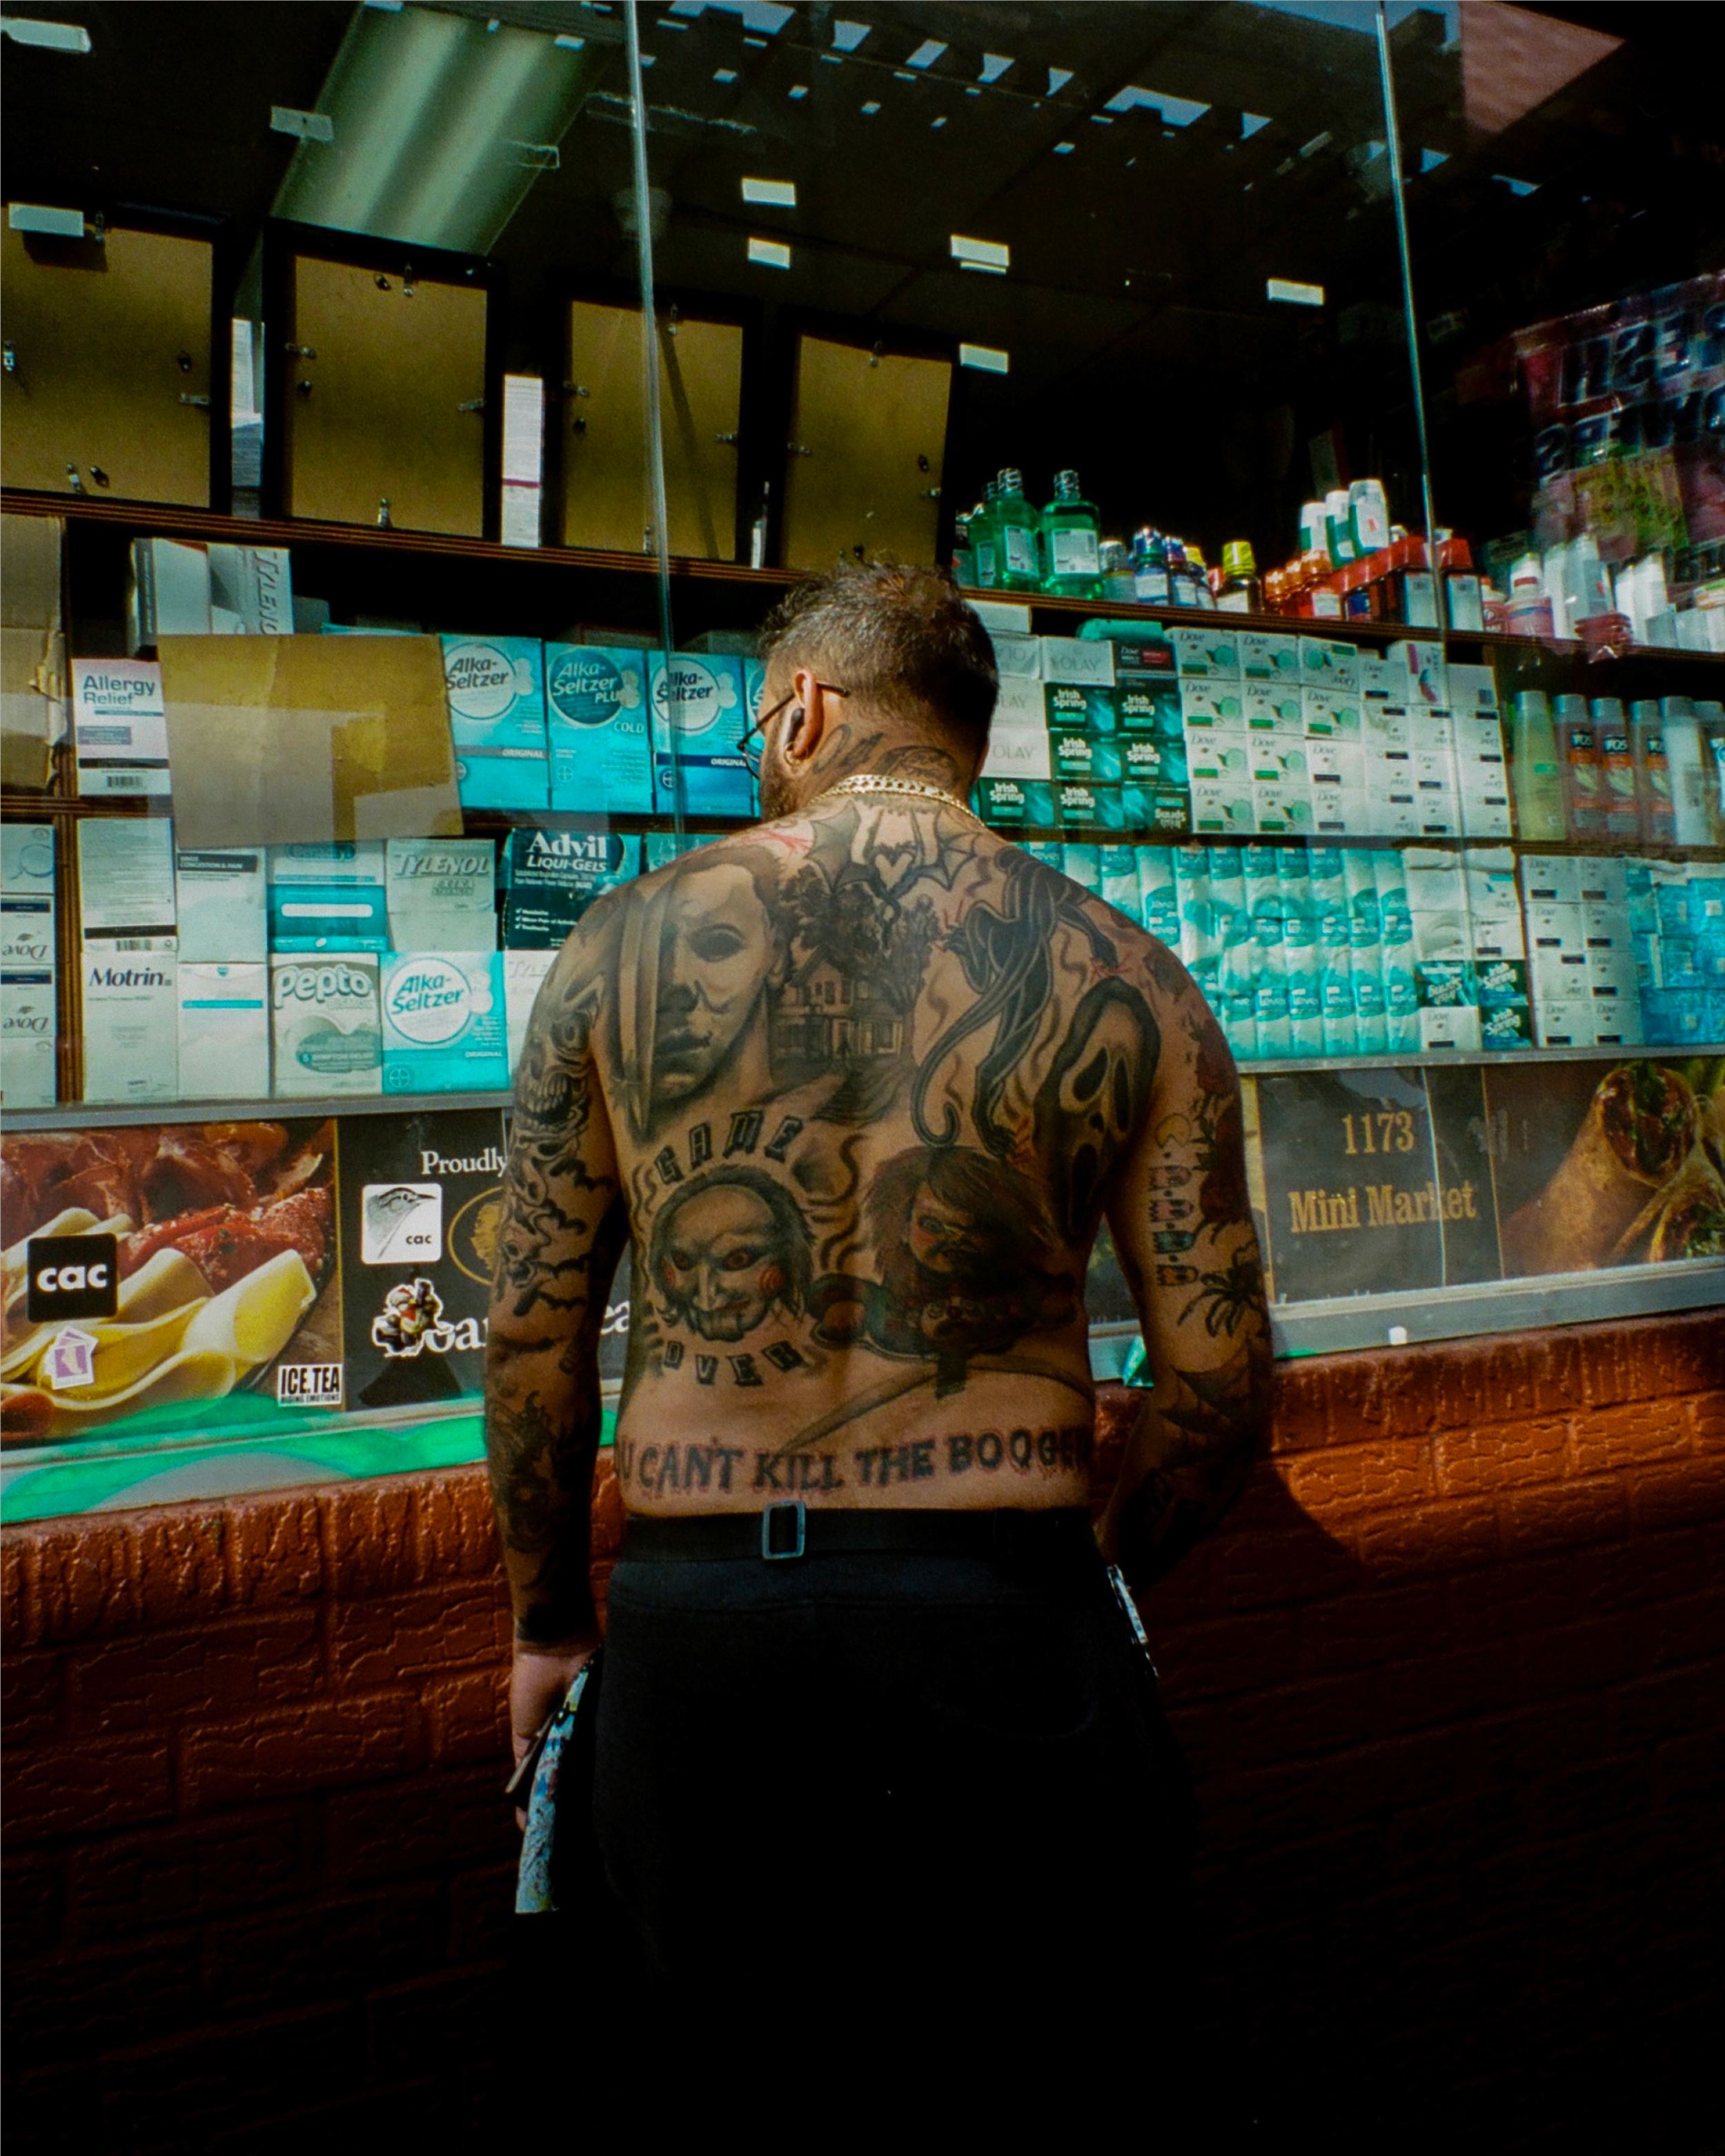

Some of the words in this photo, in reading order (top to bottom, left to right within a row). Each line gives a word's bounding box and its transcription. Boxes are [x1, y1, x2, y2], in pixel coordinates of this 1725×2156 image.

[1180, 631, 1205, 642] Dove
[1244, 634, 1269, 646] Dove
[449, 657, 497, 674] Alka-
[557, 661, 606, 680] Alka-
[83, 674, 155, 696] Allergy
[446, 672, 509, 691] Seltzer
[553, 677, 618, 696] Seltzer
[83, 691, 133, 705] Relief
[1058, 688, 1081, 700] Irish
[1127, 694, 1149, 705] Irish
[1053, 695, 1087, 711] Spring
[1122, 700, 1156, 716] Spring
[614, 721, 644, 734] COLD
[1063, 737, 1087, 749] Irish
[1132, 742, 1155, 754] Irish
[502, 748, 545, 758] ORIGINAL
[1058, 745, 1093, 760] Spring
[1126, 749, 1161, 765] Spring
[994, 782, 1018, 794] Irish
[1065, 787, 1089, 798] Irish
[989, 789, 1025, 805] Spring
[1060, 794, 1096, 808] Spring
[526, 832, 607, 859] Advil
[393, 853, 491, 877] TYLENOL
[2, 945, 48, 961] Dove
[89, 966, 164, 987] Motrin
[395, 973, 451, 997] Alka-
[391, 988, 464, 1016] Seltzer
[3, 1017, 48, 1033] Dove
[1342, 1110, 1414, 1155] 1173
[421, 1146, 506, 1178] Proudly
[1288, 1186, 1361, 1233] Mini
[1368, 1178, 1478, 1228] Market
[406, 1233, 433, 1246] cac
[37, 1264, 108, 1293] cac
[281, 1366, 341, 1395] ICE.TEA
[753, 1452, 846, 1491] KILL
[854, 1438, 937, 1486] THE
